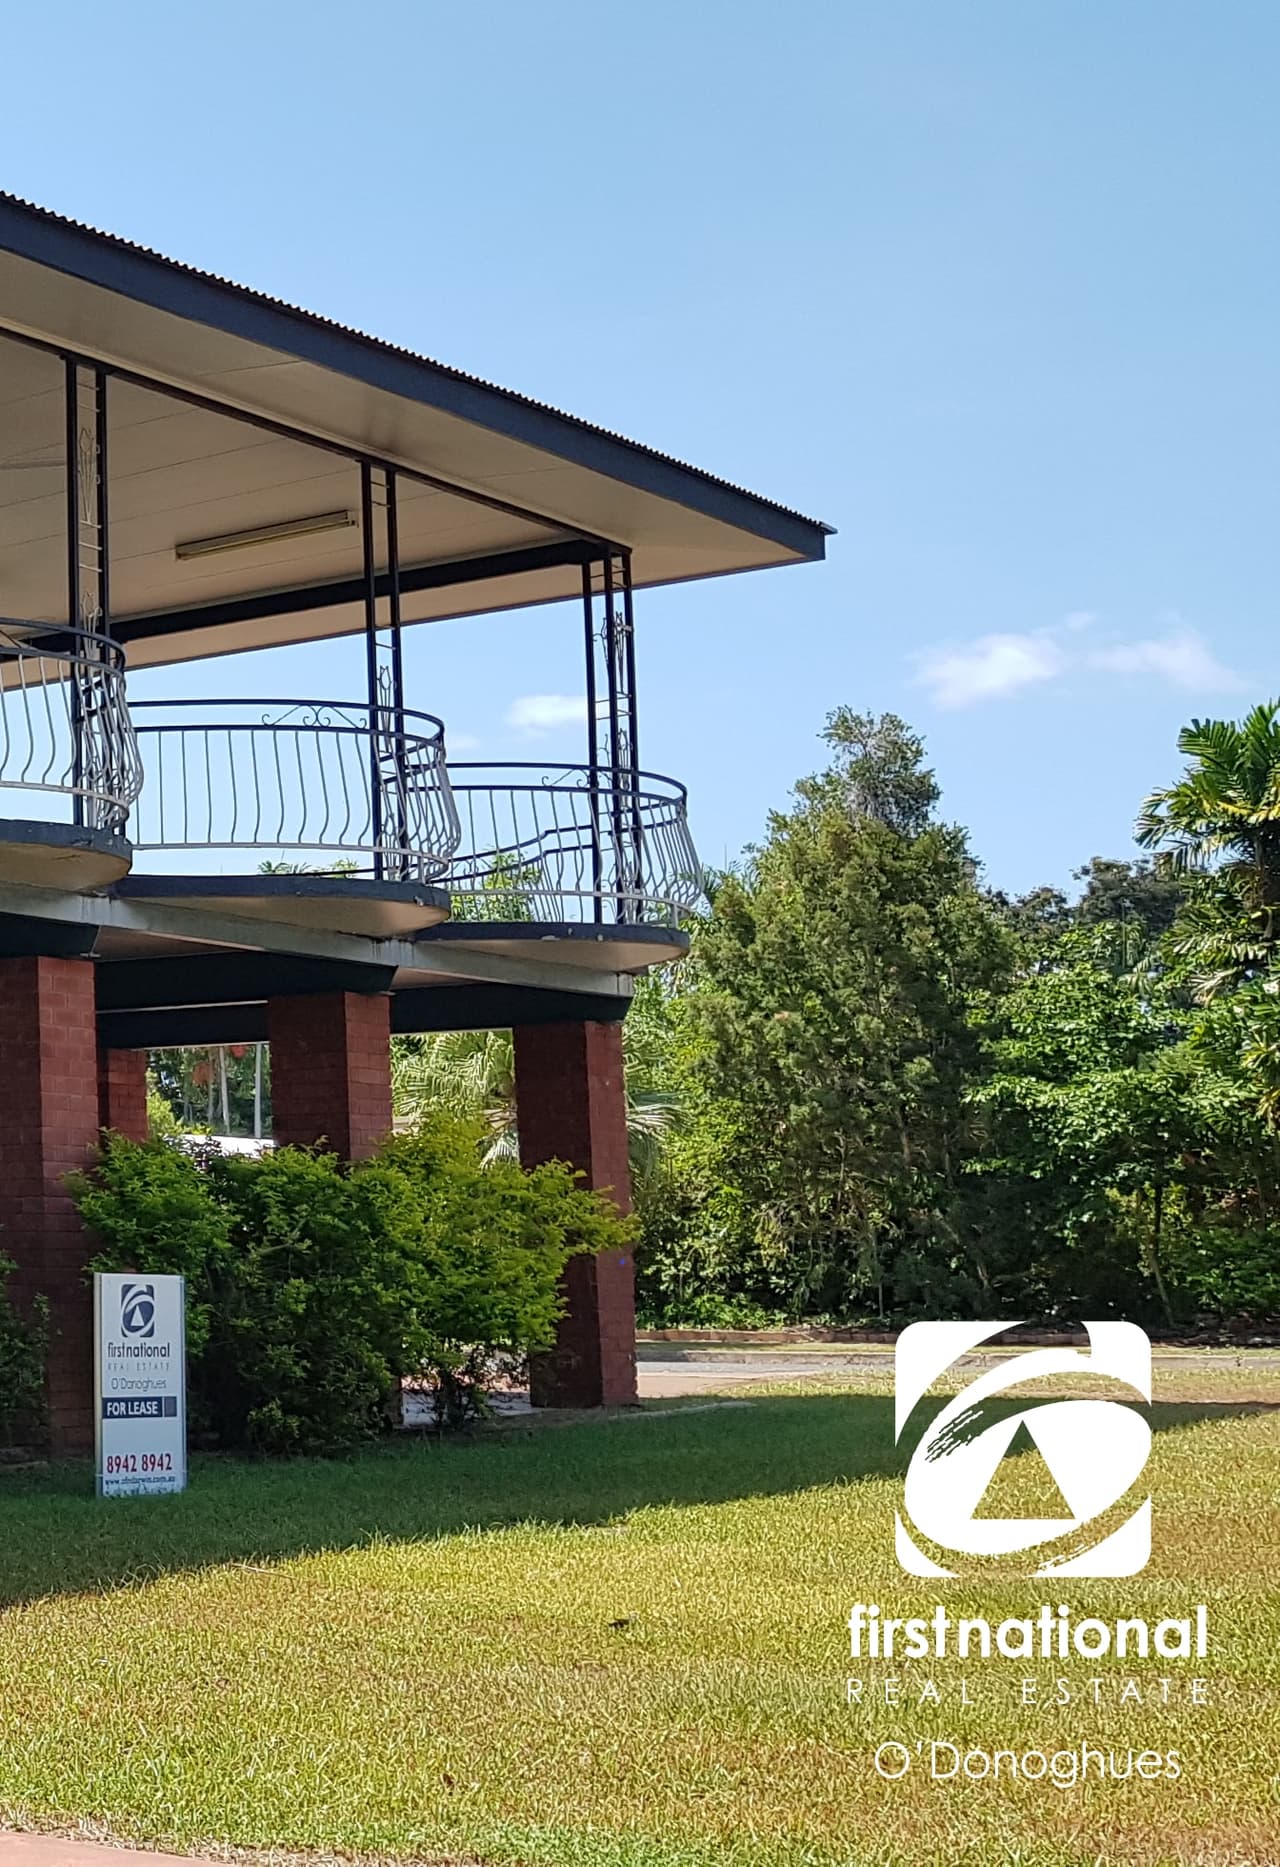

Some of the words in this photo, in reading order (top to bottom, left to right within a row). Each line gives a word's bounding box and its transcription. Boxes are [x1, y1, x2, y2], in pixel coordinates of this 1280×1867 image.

[108, 1362, 130, 1371] REAL
[136, 1361, 170, 1371] ESTATE
[111, 1377, 167, 1392] O'Donoghues
[107, 1402, 126, 1416] FOR
[128, 1401, 158, 1415] LEASE
[107, 1455, 137, 1473] 8942
[141, 1453, 172, 1472] 8942
